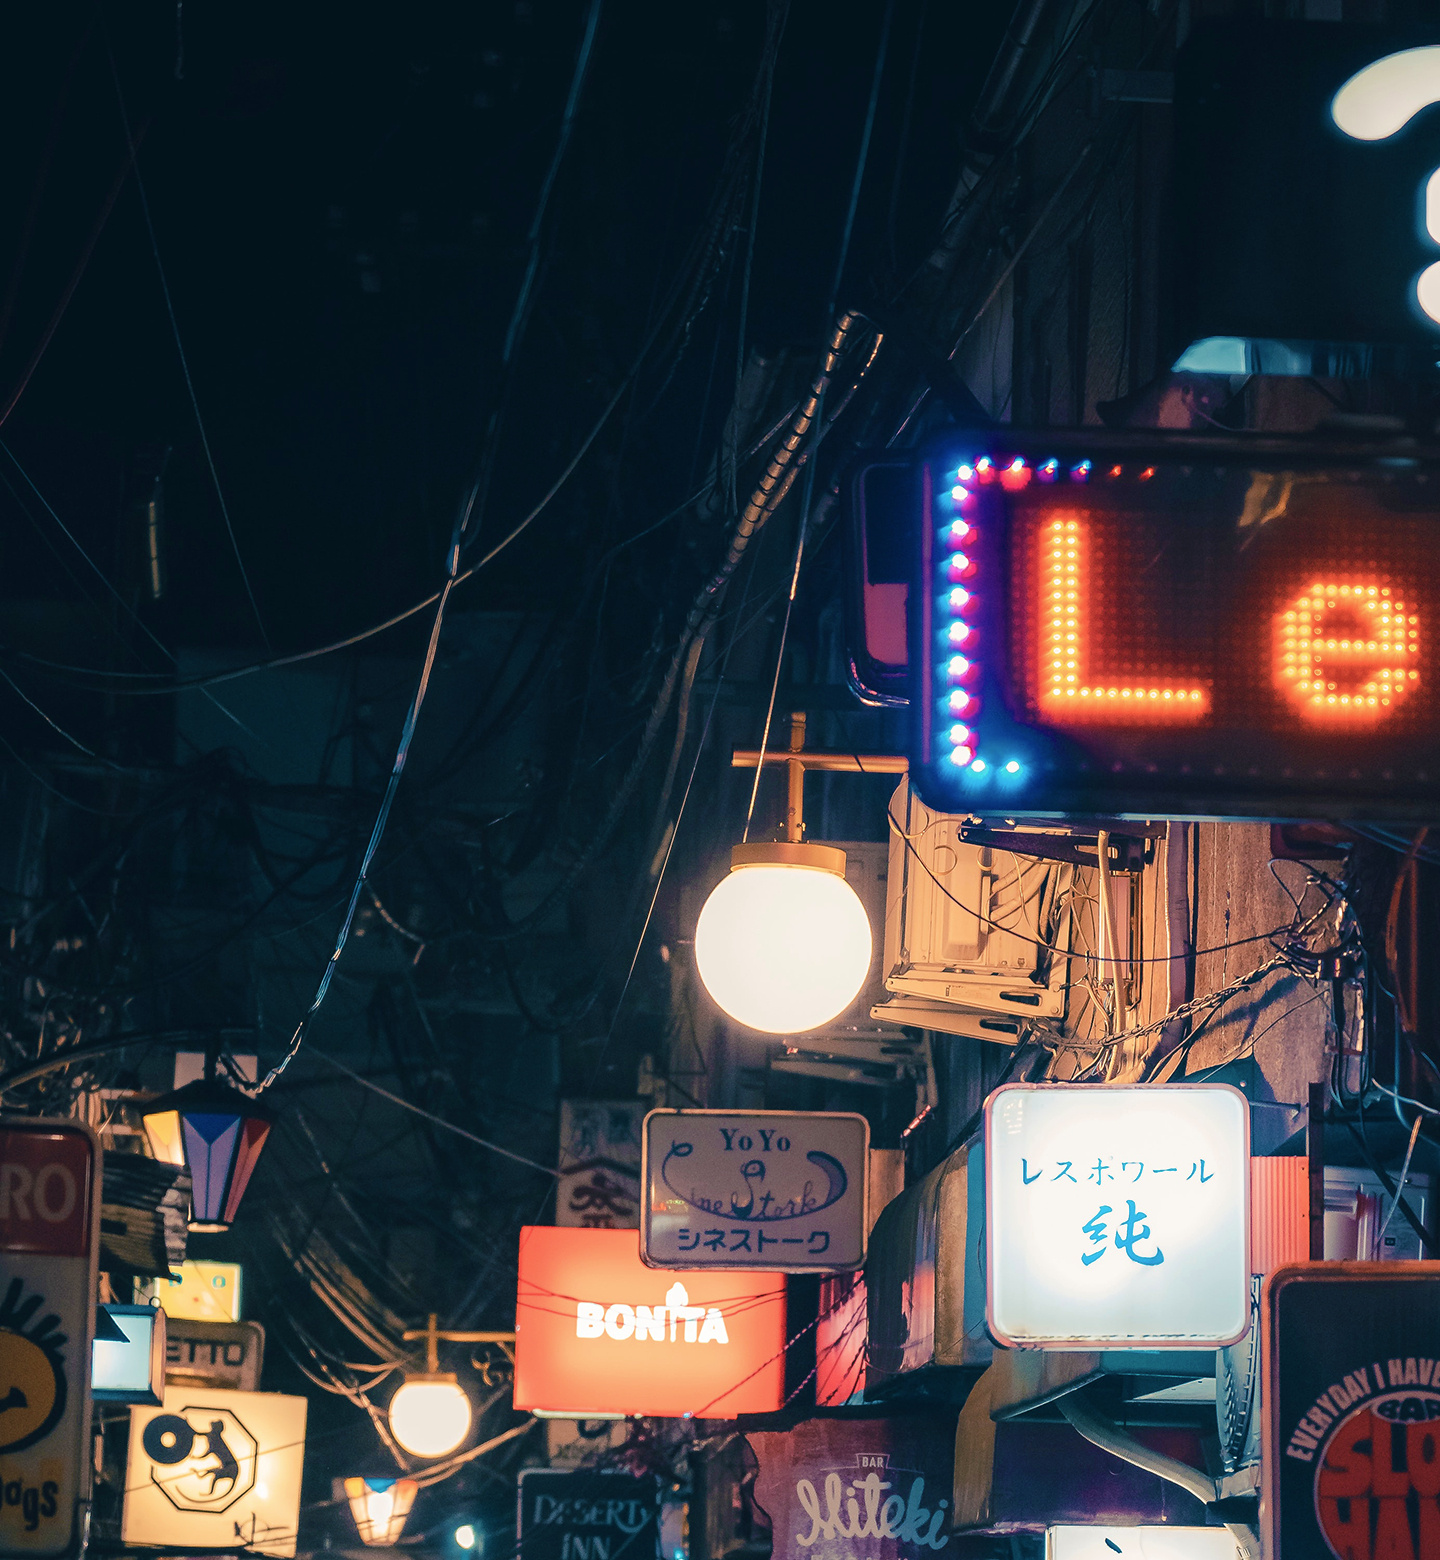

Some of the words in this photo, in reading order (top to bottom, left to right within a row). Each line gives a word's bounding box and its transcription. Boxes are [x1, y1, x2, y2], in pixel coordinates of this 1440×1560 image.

[1044, 515, 1420, 715] Le
[1021, 1157, 1215, 1186] レスポワール
[678, 1228, 830, 1254] シネストーク
[1081, 1200, 1165, 1266] 純
[576, 1282, 729, 1344] BONITA
[1286, 1367, 1371, 1462] EVERYDAY
[862, 1456, 884, 1468] BAR
[0, 1476, 59, 1532] ogs
